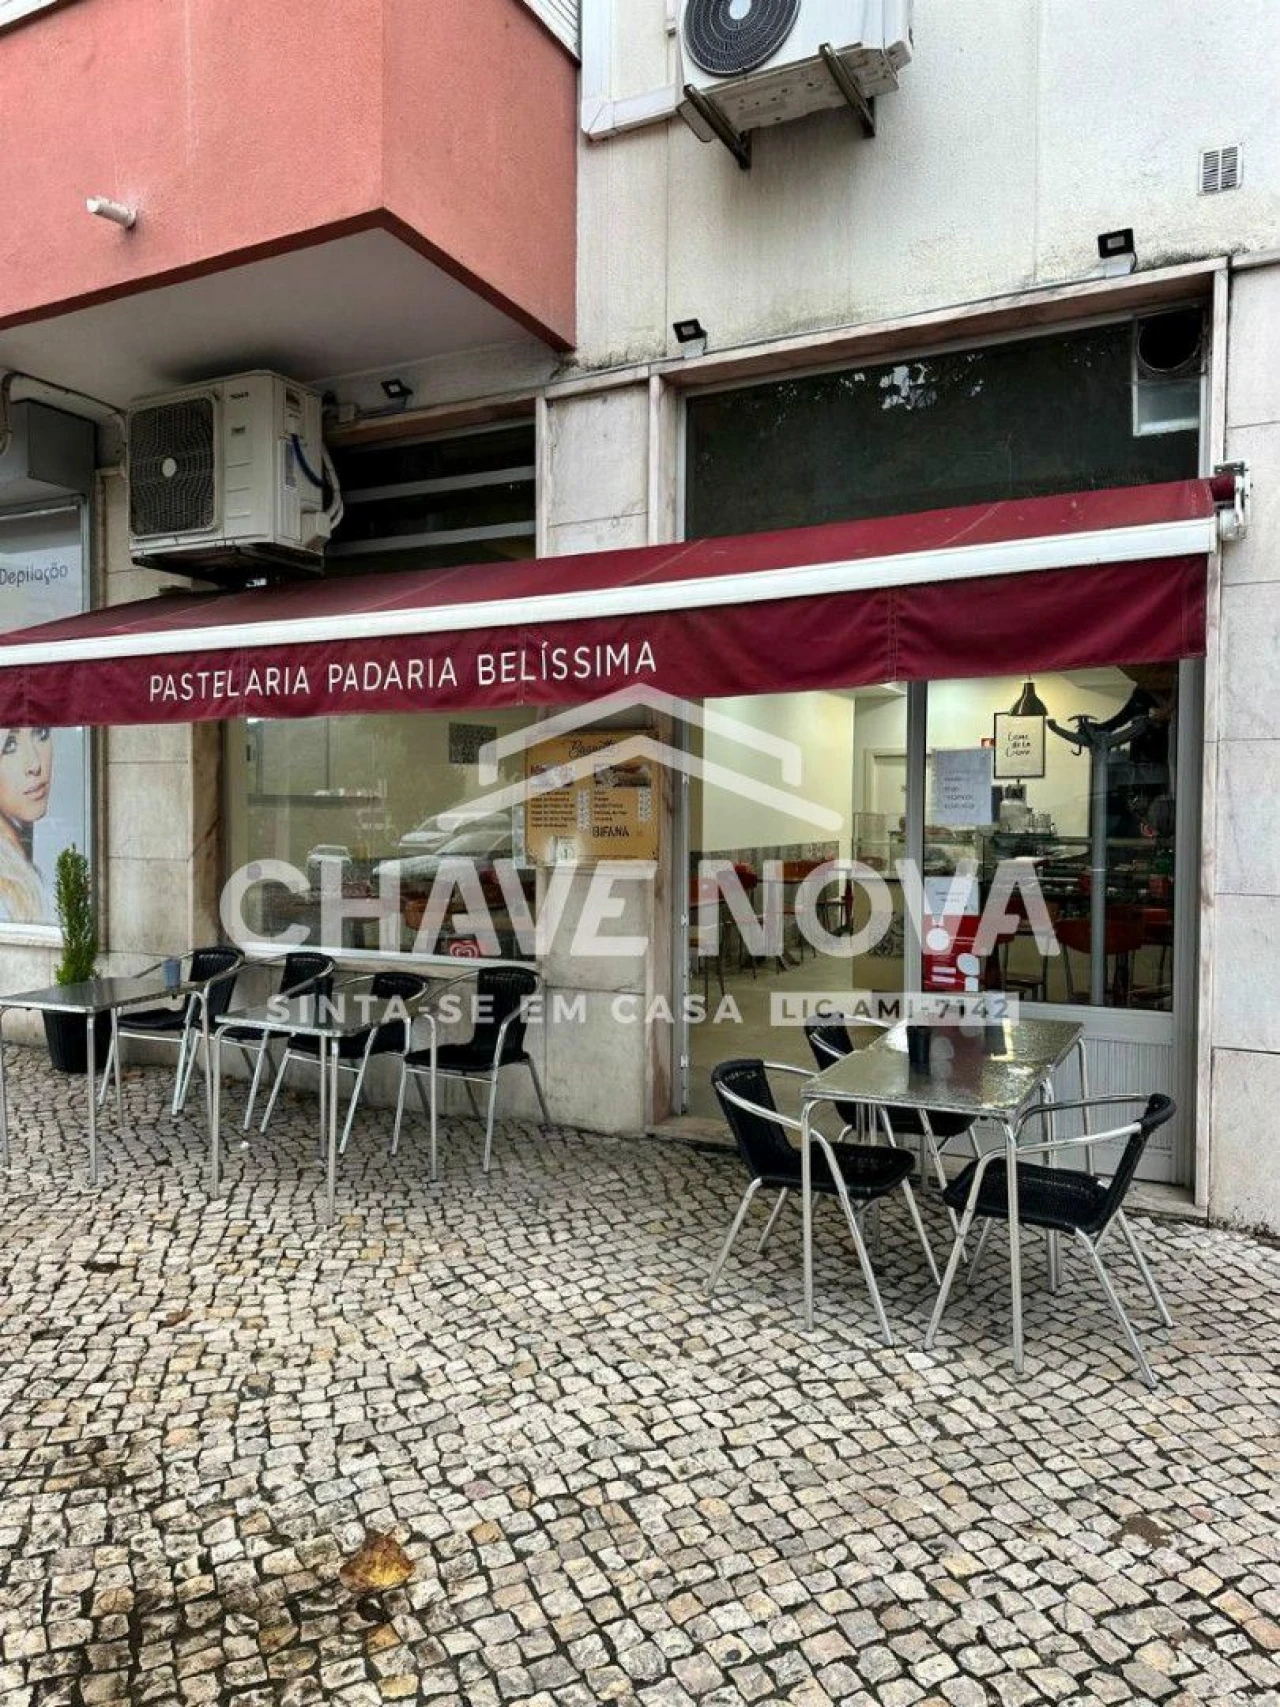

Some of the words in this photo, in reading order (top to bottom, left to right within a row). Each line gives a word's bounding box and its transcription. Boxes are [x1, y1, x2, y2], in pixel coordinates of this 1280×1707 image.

[149, 666, 311, 701] PASTELARIA
[328, 656, 458, 693] PADARIA
[477, 641, 657, 686] BELÍSSIMA
[592, 825, 630, 838] BIFANA
